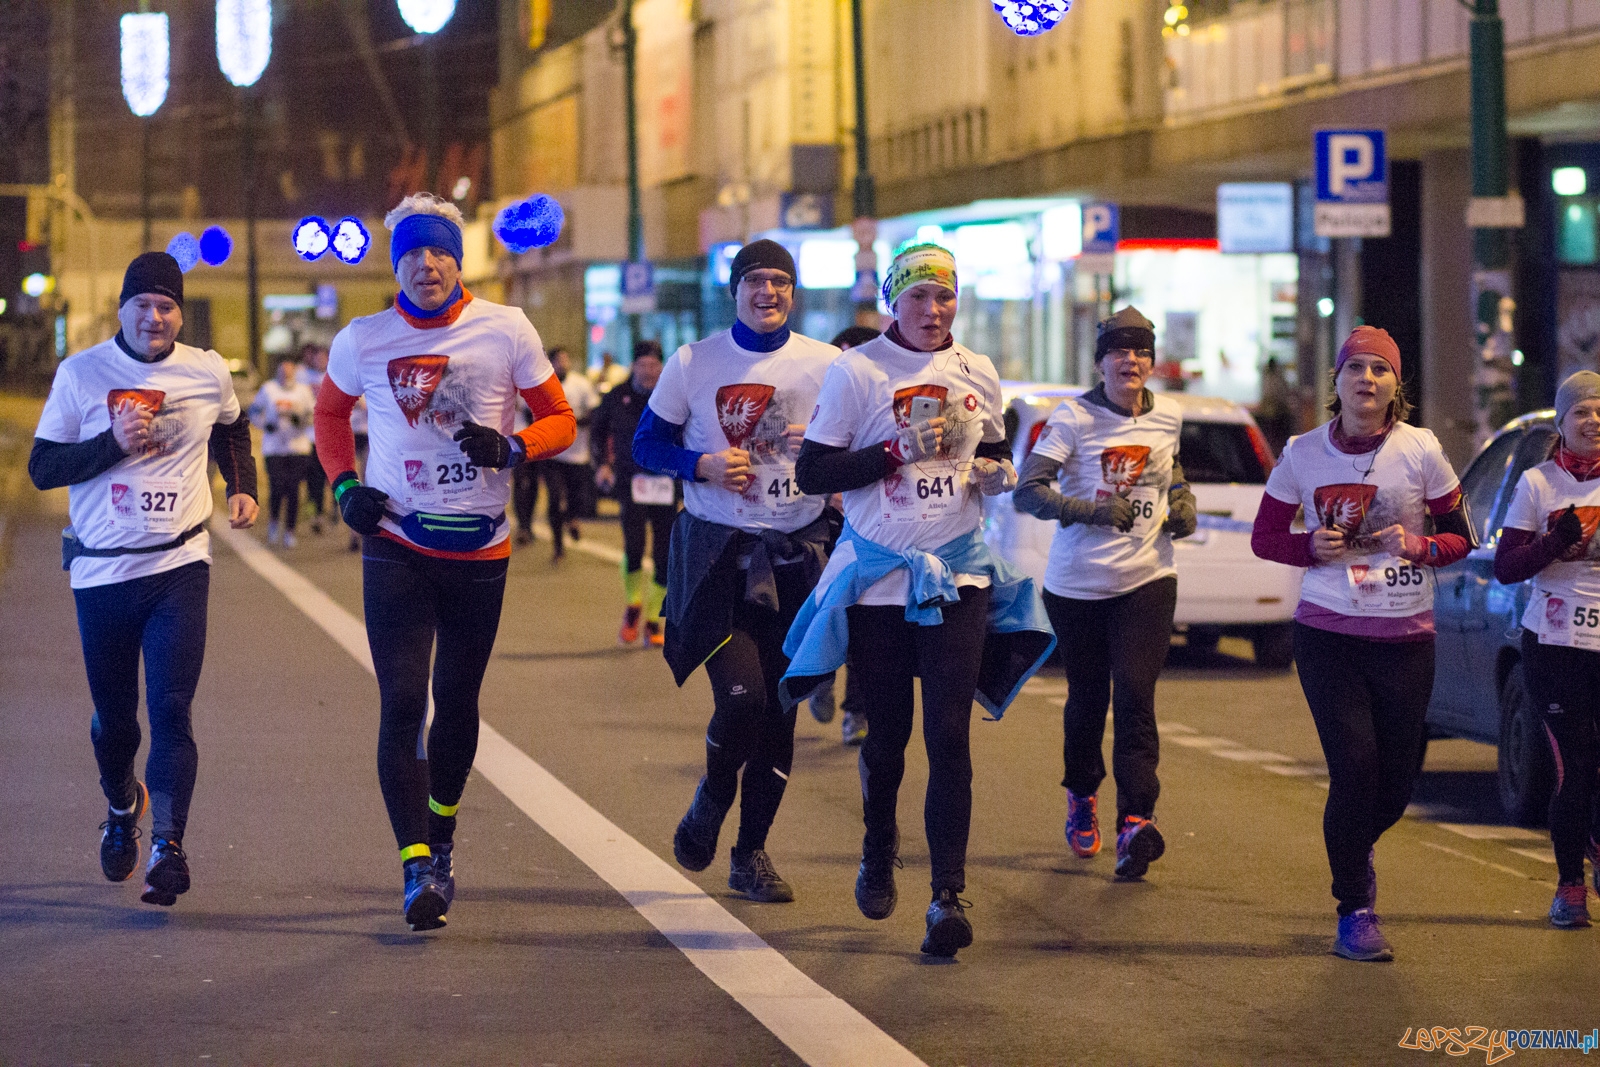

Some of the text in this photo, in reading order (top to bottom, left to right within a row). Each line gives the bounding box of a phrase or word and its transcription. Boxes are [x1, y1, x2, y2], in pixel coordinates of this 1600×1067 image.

[1328, 134, 1374, 194] P
[1083, 206, 1110, 241] P
[437, 463, 477, 485] 235
[917, 475, 954, 499] 641
[141, 491, 178, 512] 327
[1125, 499, 1154, 519] 66
[1384, 565, 1423, 587] 955
